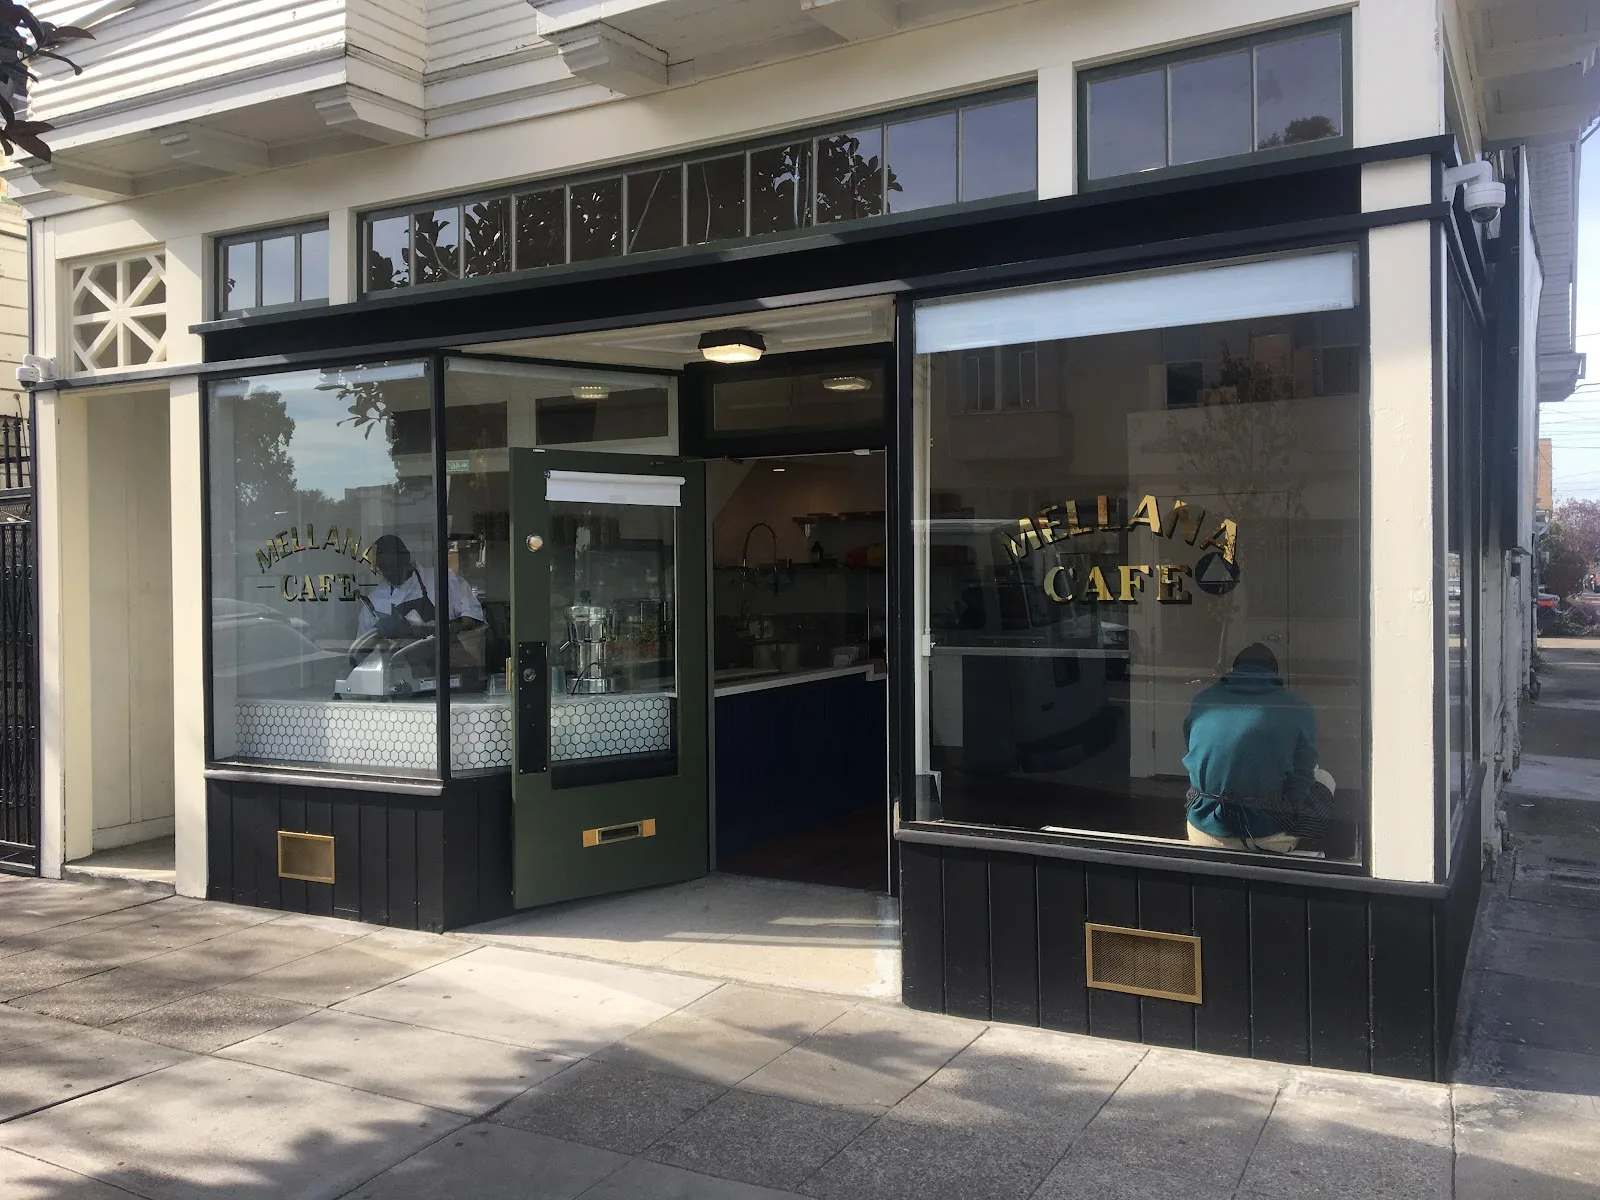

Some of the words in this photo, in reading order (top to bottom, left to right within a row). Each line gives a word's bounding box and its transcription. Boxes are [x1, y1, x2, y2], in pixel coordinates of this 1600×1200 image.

[255, 523, 377, 576] MELLANA
[1000, 494, 1237, 565] MELLANA
[281, 573, 356, 602] CAFE
[1043, 564, 1193, 605] CAFE
